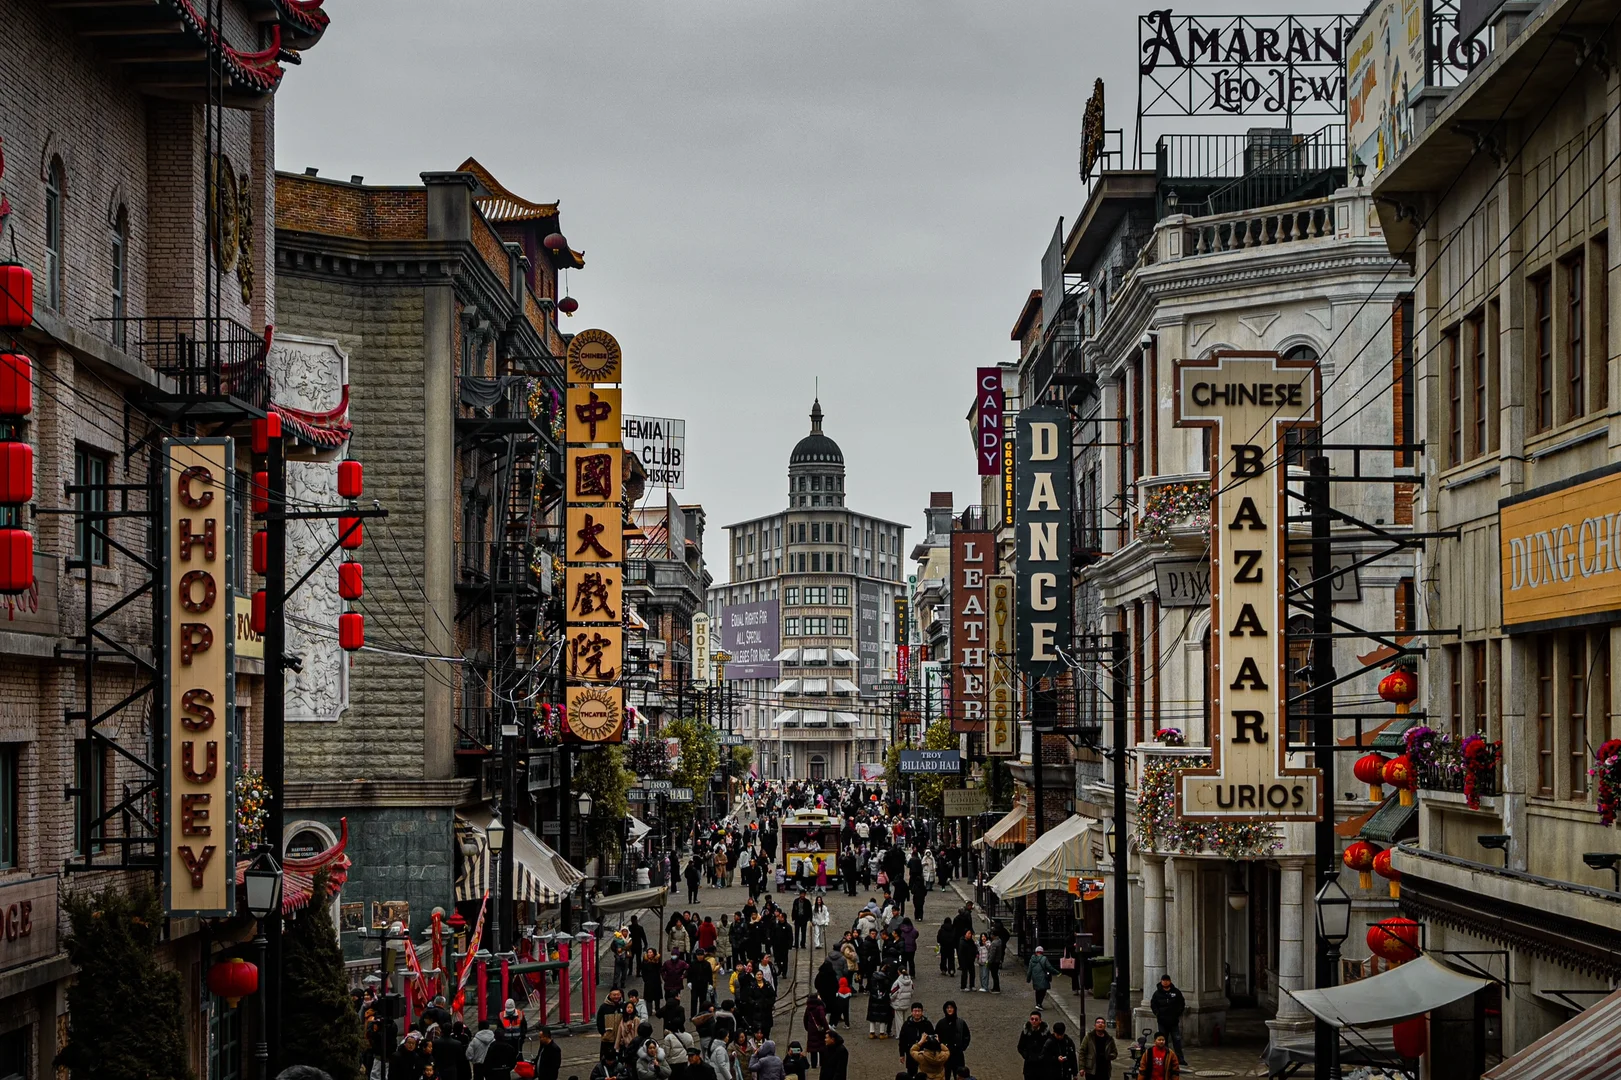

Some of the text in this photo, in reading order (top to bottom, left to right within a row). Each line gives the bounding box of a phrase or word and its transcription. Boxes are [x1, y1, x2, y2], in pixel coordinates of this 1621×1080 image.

[982, 375, 998, 466] CANDY
[1191, 382, 1303, 406] CHINESE
[643, 446, 681, 467] CLUB
[178, 466, 217, 665] CHOP
[1026, 422, 1061, 661] DANCE
[1509, 523, 1576, 591] DUNG
[760, 609, 768, 624] FOR
[1228, 444, 1269, 744] BAZAAR
[696, 623, 706, 679] HOTEL
[961, 542, 985, 720] LEATHER
[727, 736, 742, 744] HALL
[995, 689, 1007, 747] SOAP
[177, 688, 218, 889] SUEY
[901, 760, 938, 770] BILIARD
[670, 789, 692, 800] HALL
